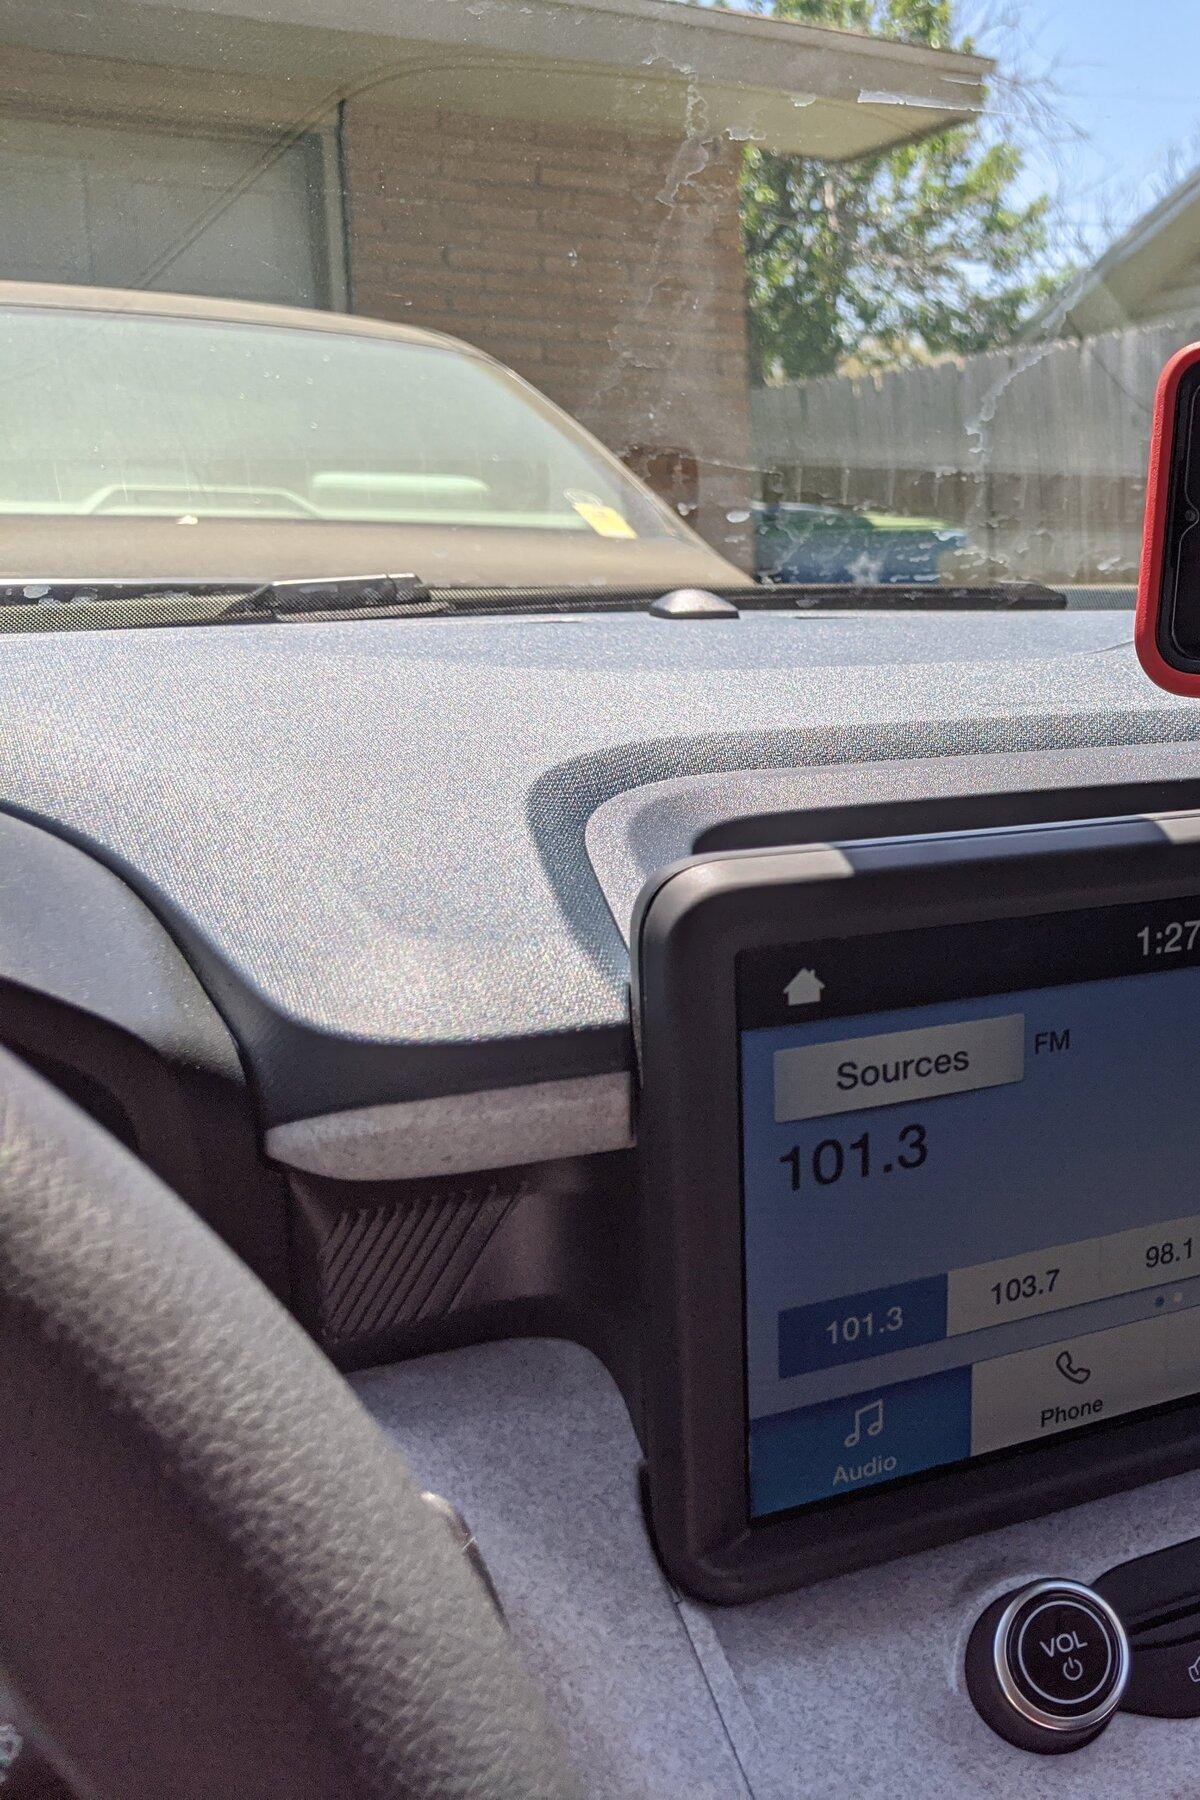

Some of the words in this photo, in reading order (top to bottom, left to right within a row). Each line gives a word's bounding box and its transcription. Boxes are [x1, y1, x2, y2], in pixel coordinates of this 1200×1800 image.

[1034, 1029, 1071, 1055] FM
[835, 1047, 970, 1091] Sources
[779, 1123, 929, 1193] 101.3
[1144, 1238, 1195, 1268] 98.1
[990, 1268, 1061, 1305] 103.7
[825, 1306, 904, 1345] 101.3
[1039, 1396, 1104, 1428] Phone
[831, 1451, 898, 1487] Audio
[1038, 1631, 1088, 1659] VOL
